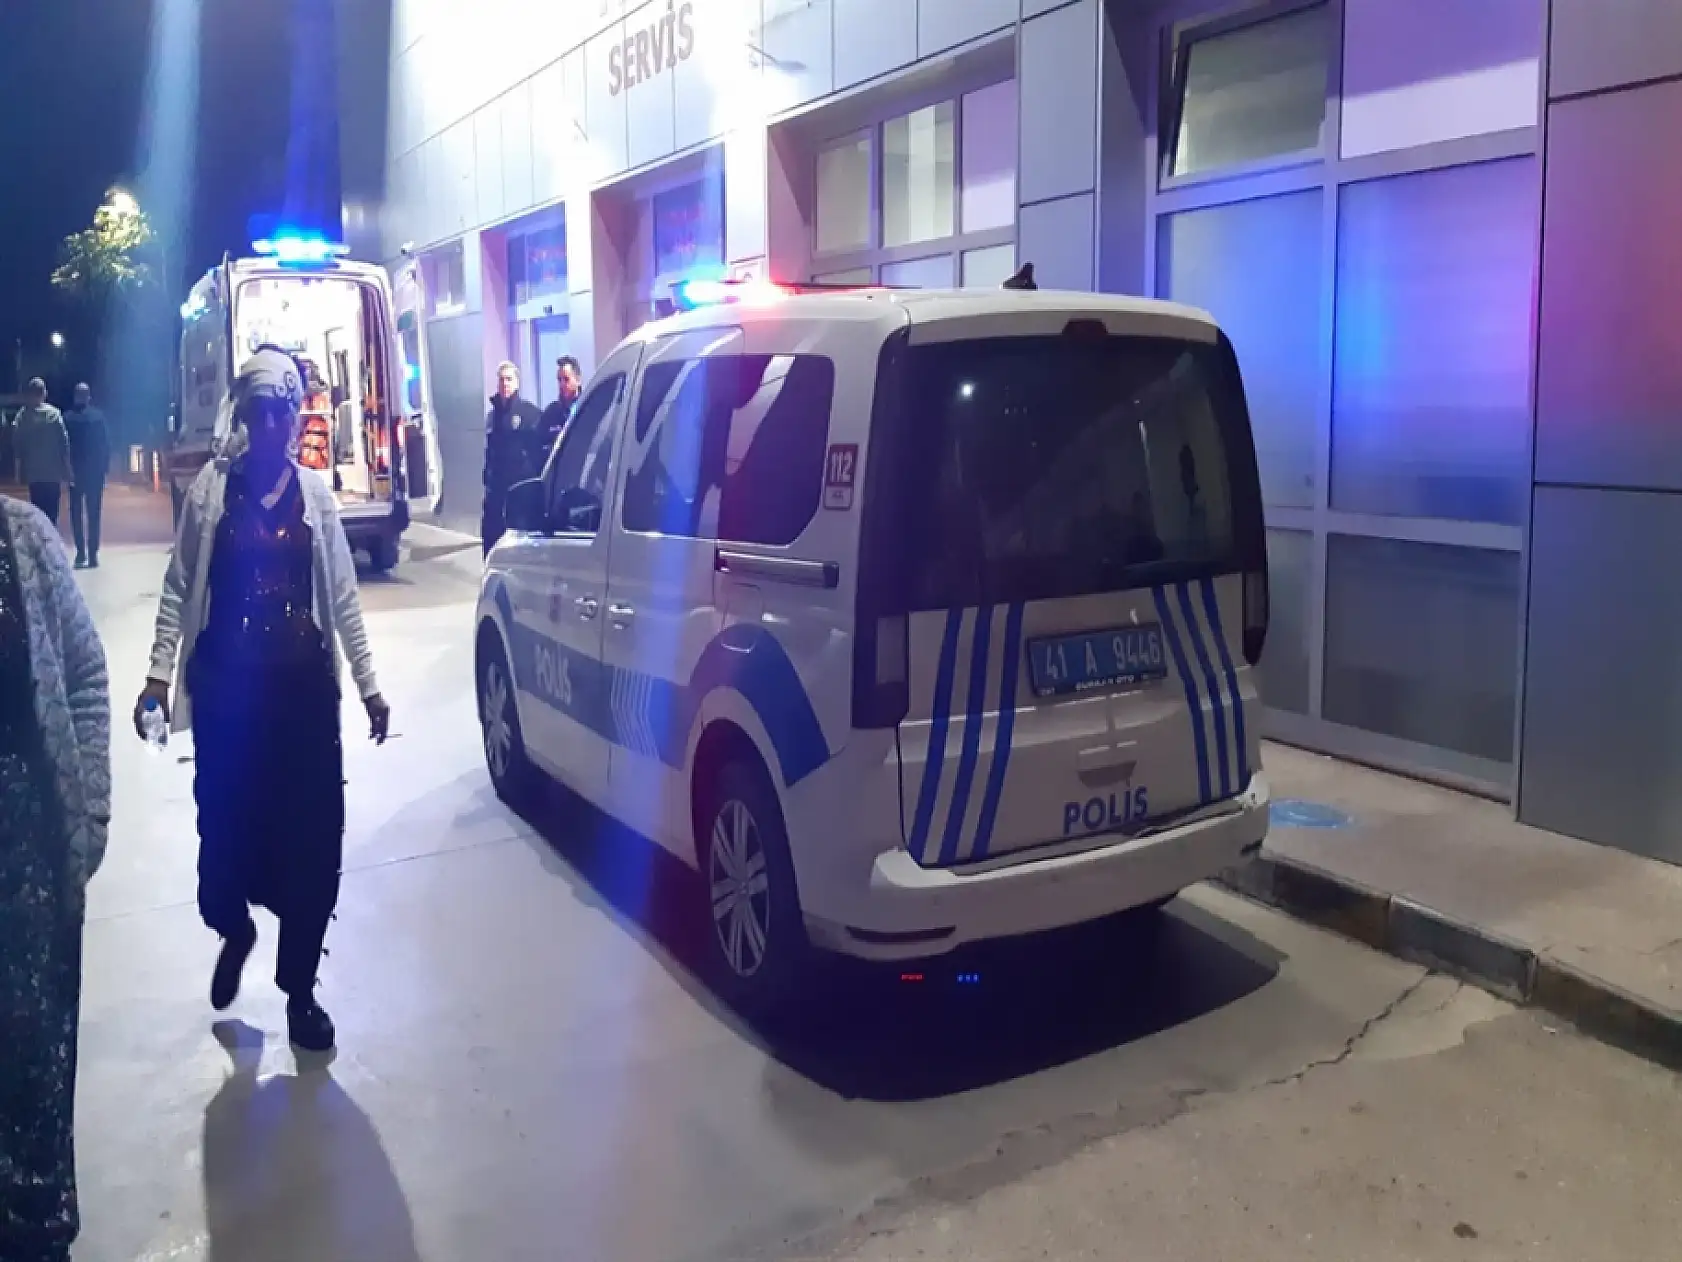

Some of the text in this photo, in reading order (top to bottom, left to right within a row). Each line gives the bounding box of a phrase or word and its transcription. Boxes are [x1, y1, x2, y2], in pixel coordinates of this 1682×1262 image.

[608, 0, 695, 97] SERVİS
[830, 450, 854, 483] 112
[1046, 643, 1068, 680] 41
[1085, 639, 1098, 677] A
